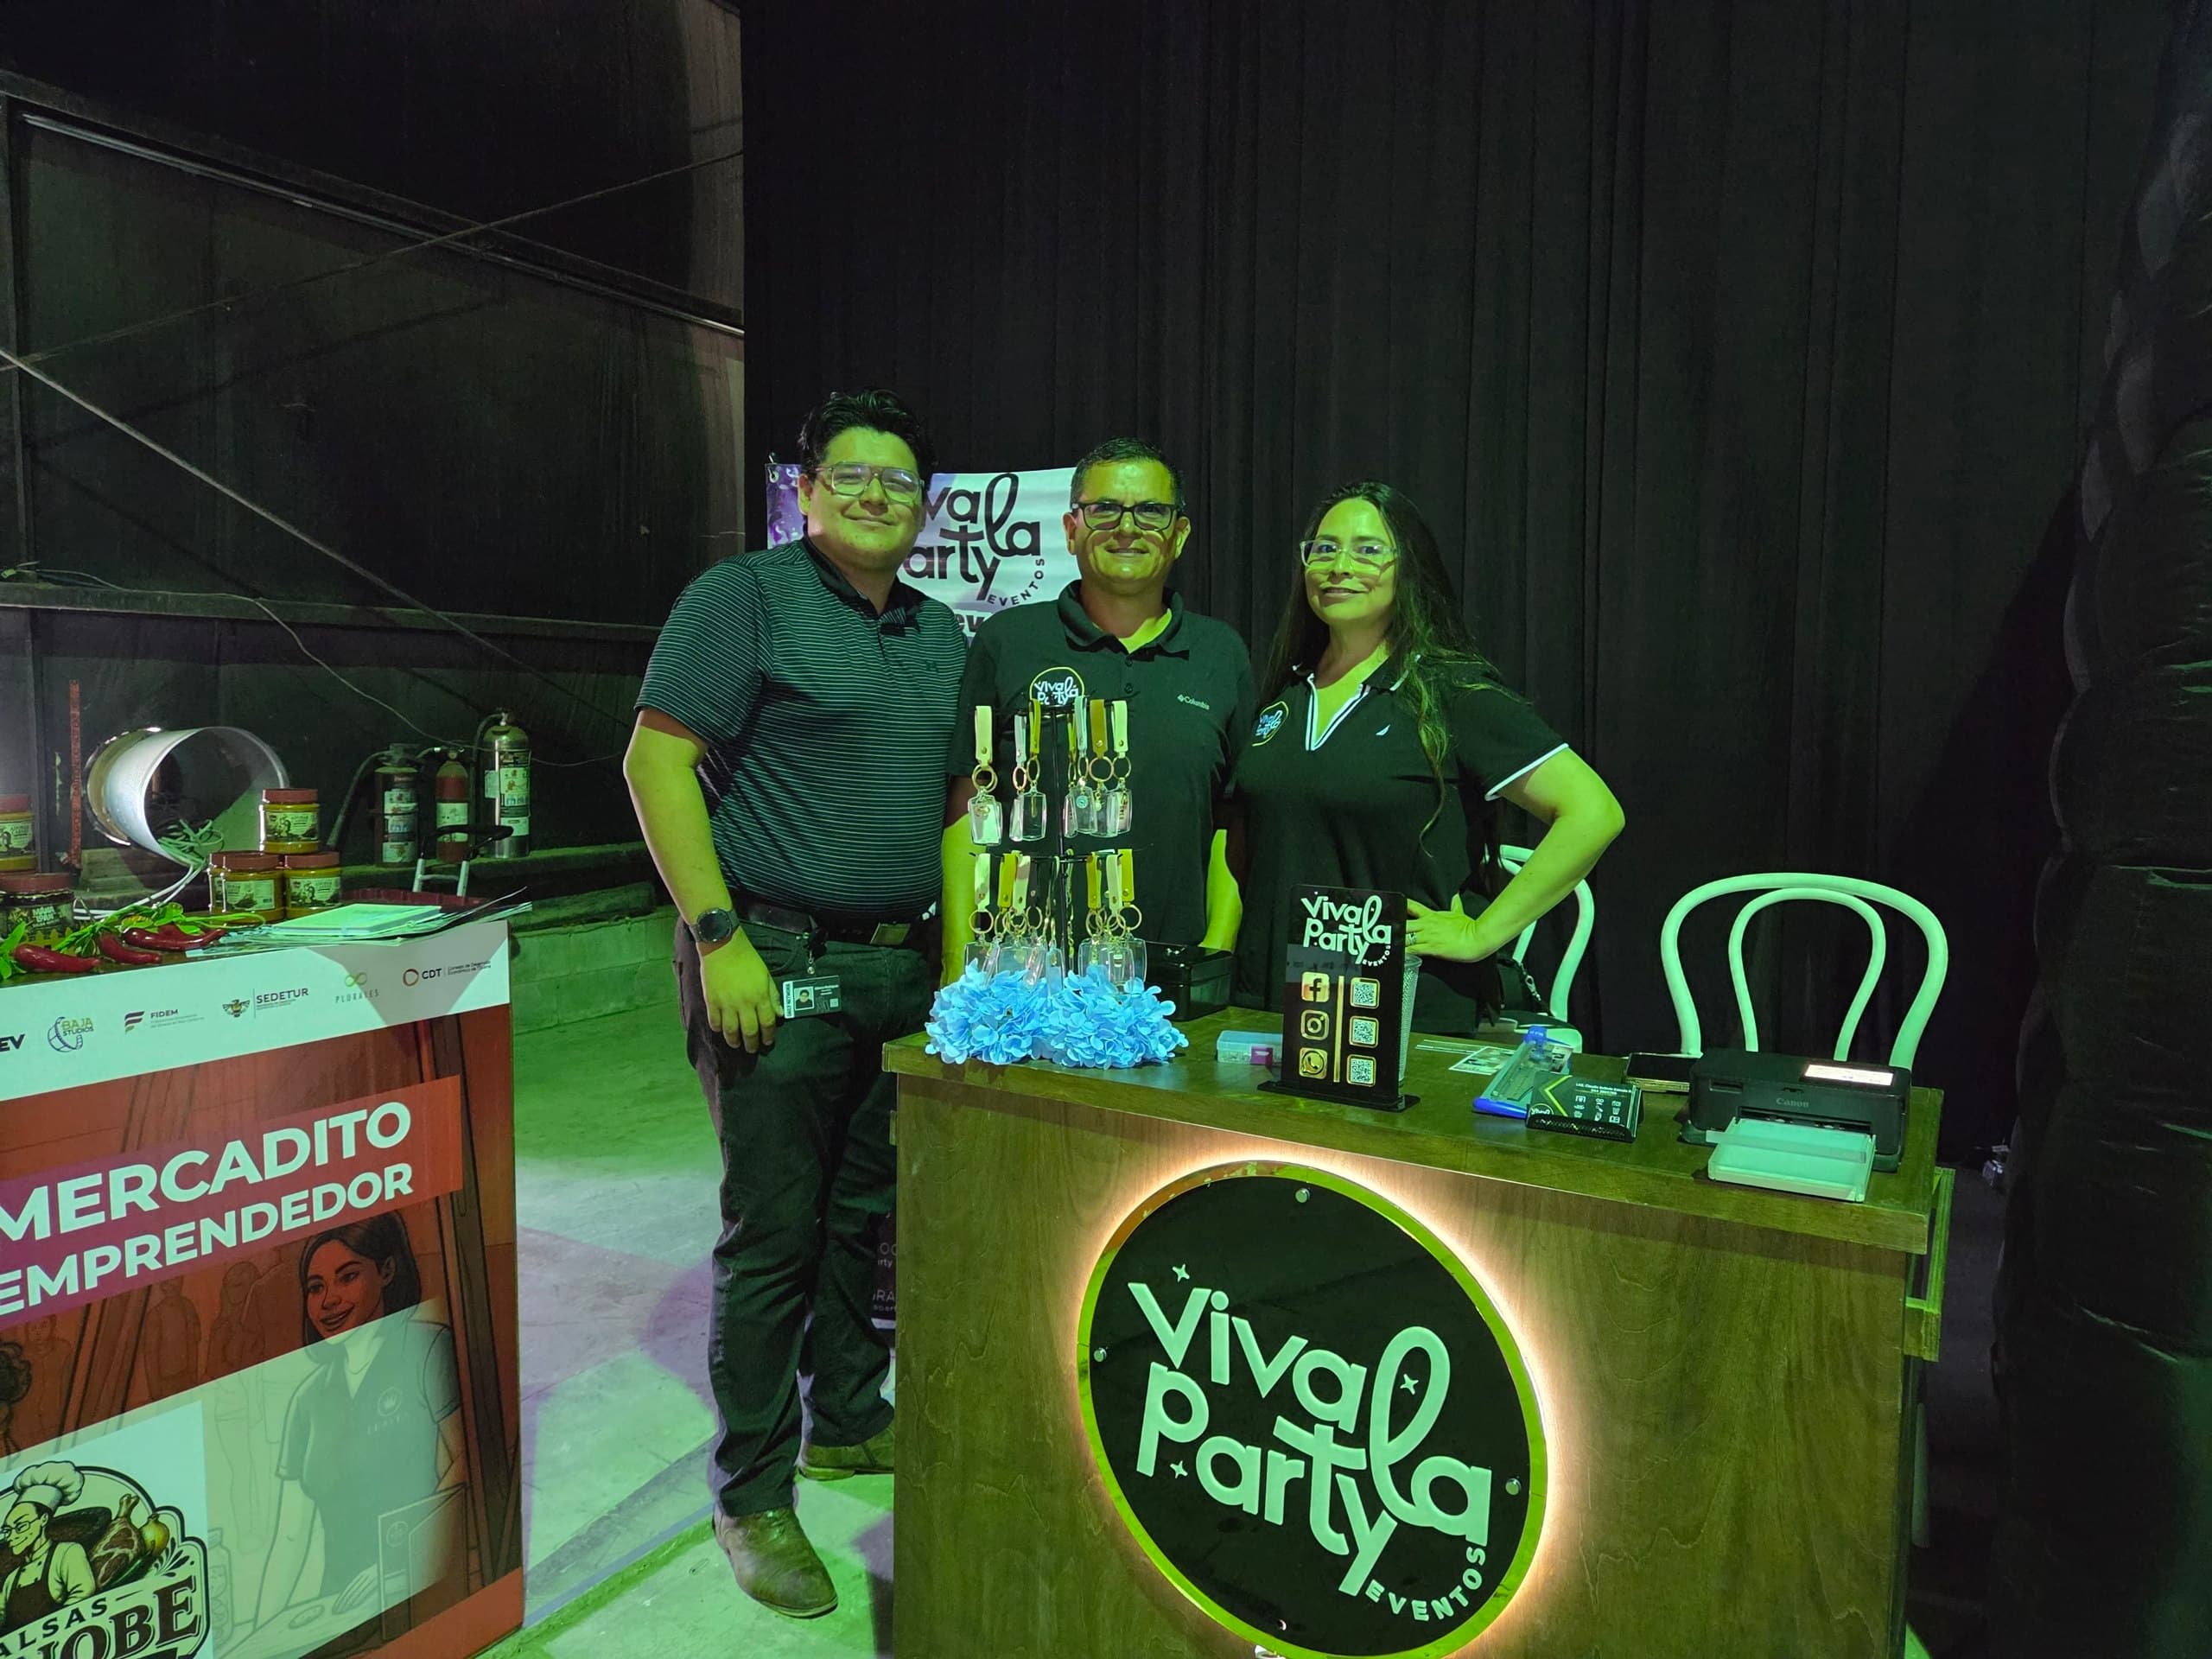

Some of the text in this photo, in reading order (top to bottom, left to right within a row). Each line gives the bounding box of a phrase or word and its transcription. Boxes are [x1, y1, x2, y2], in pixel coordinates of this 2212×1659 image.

[925, 486, 982, 524] va
[903, 525, 1001, 601] arty
[987, 557, 1046, 607] EVENTOS
[1300, 895, 1363, 924] Viva
[1303, 917, 1371, 965] Party
[422, 968, 442, 980] CDT
[150, 1008, 179, 1019] FIDEM
[256, 988, 309, 1004] SEDETUR
[335, 988, 380, 1004] PLURALES
[61, 1017, 94, 1031] BAJA
[62, 1026, 94, 1037] STUDIOS
[1776, 1096, 1810, 1109] Canon
[0, 1101, 412, 1242] MERCADITO
[0, 1163, 414, 1316] EMPRENDEDOR
[1128, 1281, 1493, 1547] Viva la
[1136, 1361, 1398, 1597] Party
[1364, 1547, 1487, 1623] EVENTOS
